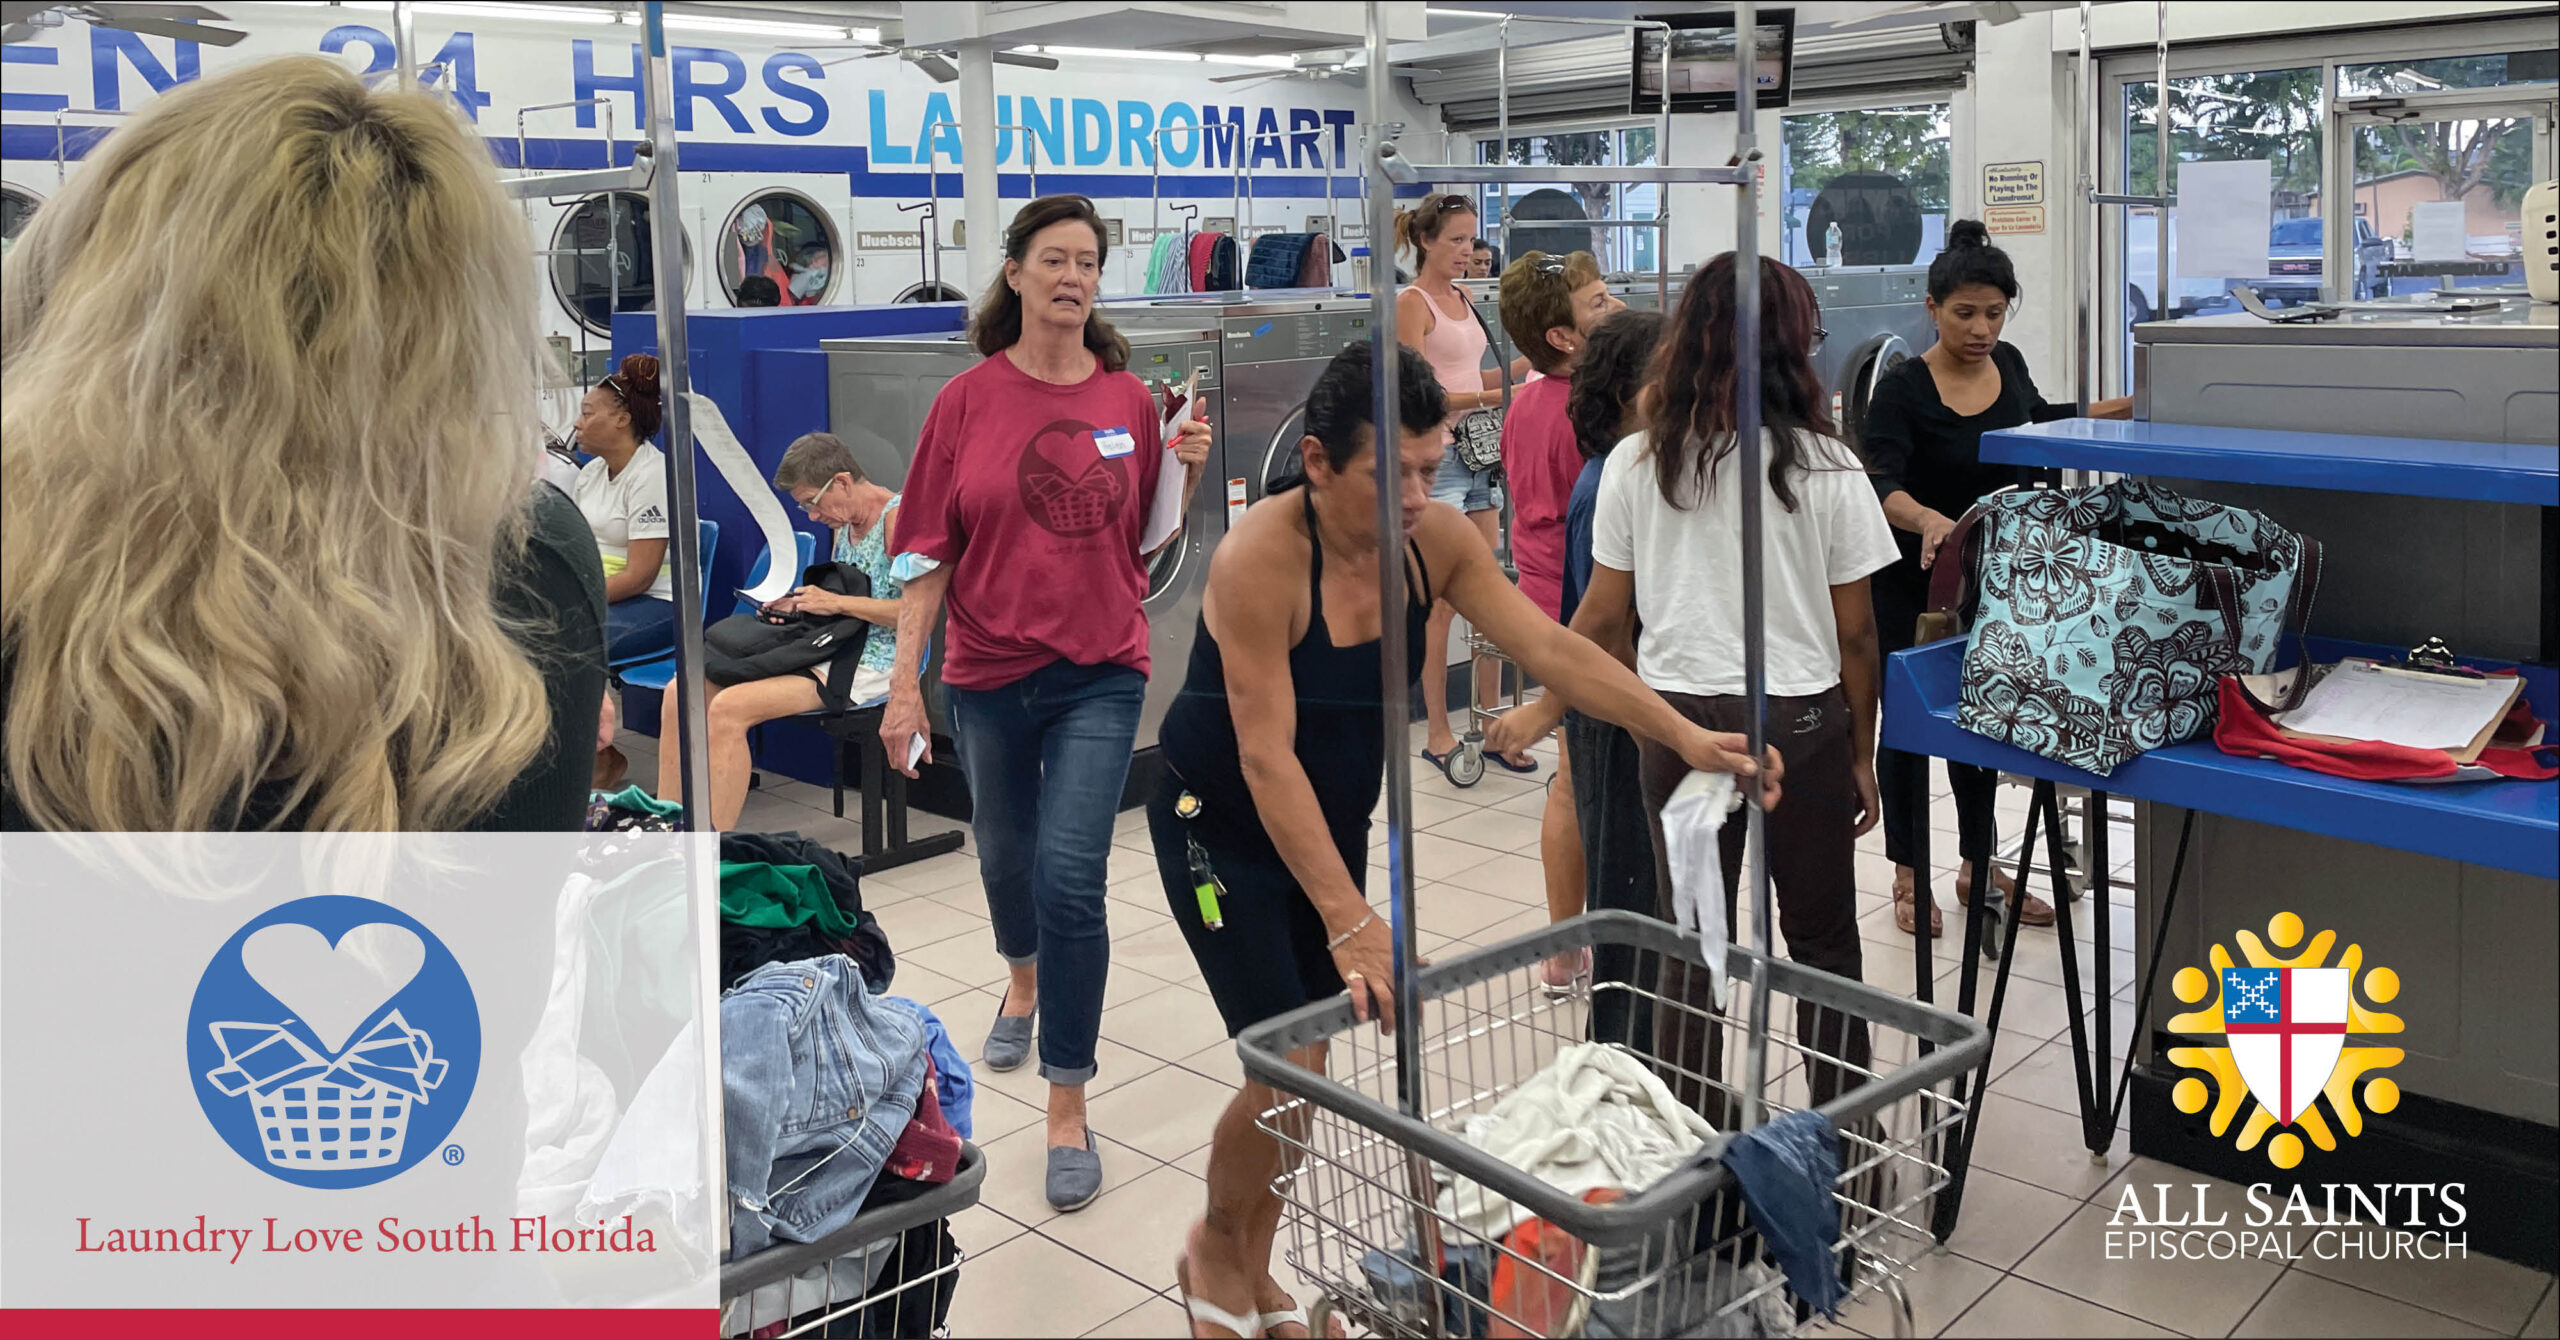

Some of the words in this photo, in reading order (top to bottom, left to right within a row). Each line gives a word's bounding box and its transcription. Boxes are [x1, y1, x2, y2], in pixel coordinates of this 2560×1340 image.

[320, 25, 491, 125] 24
[571, 38, 830, 137] HRS
[702, 172, 712, 183] 21
[2000, 173, 2028, 182] Running
[1989, 185, 2015, 193] Playing
[1993, 194, 2034, 202] Laundromat
[861, 234, 921, 248] Huebsch
[856, 257, 865, 268] 23
[542, 389, 554, 401] 20
